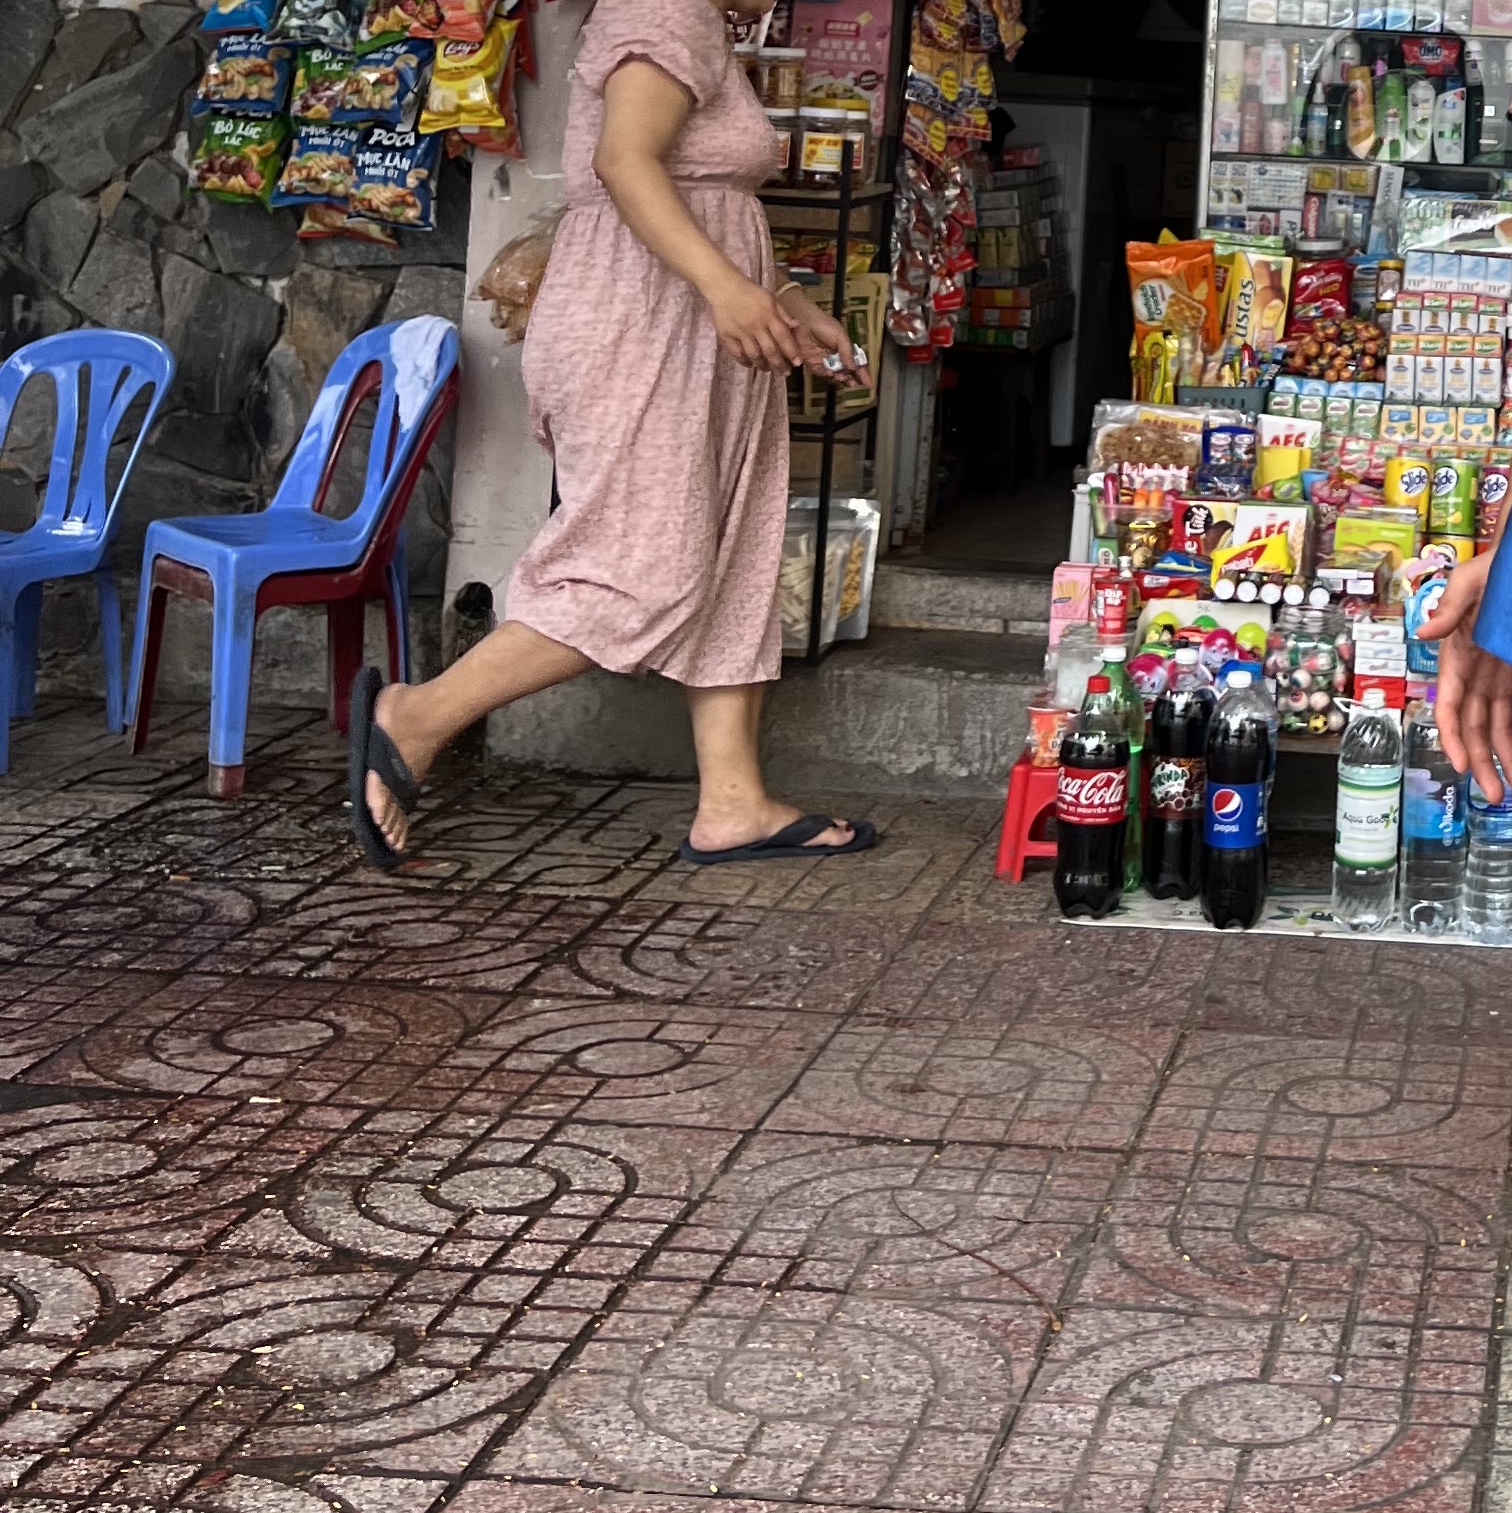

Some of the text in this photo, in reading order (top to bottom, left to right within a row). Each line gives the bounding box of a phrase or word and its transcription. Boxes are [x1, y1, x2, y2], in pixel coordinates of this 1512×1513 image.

[368, 128, 416, 147] POCA
[1269, 431, 1306, 447] AFC
[1400, 466, 1429, 491] Slide
[1249, 520, 1290, 542] AFC
[1213, 821, 1240, 834] pepsi
